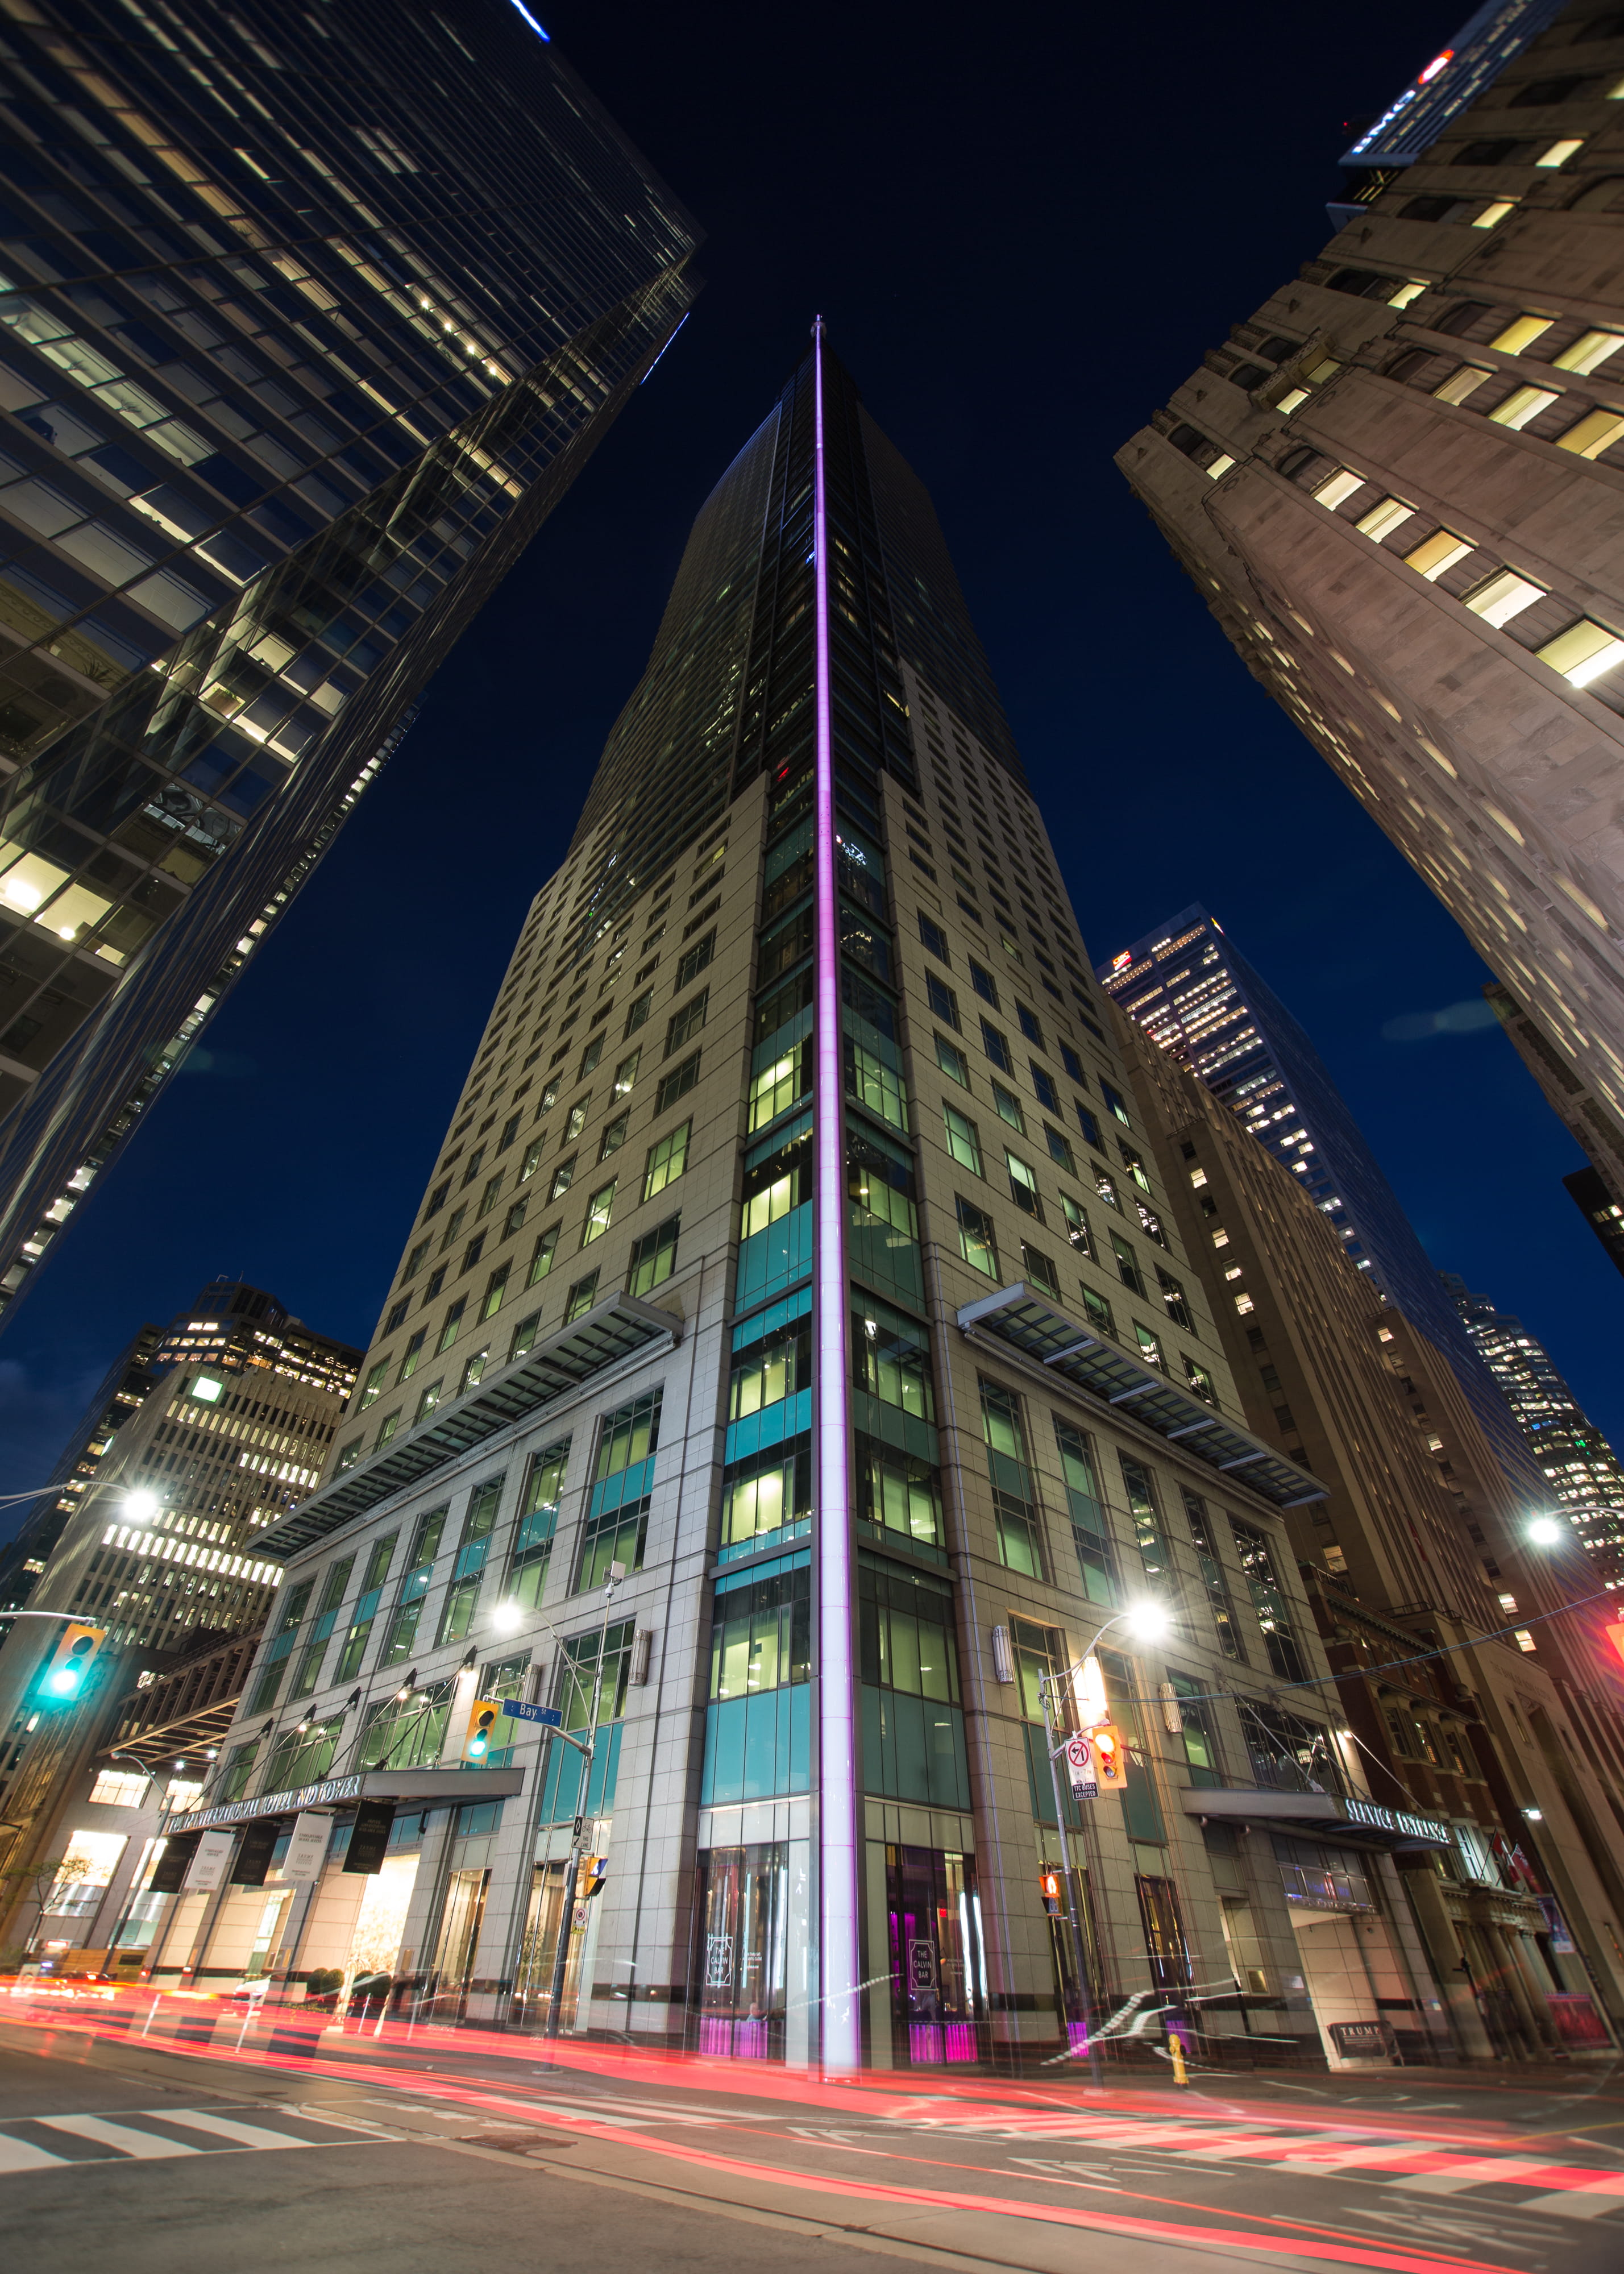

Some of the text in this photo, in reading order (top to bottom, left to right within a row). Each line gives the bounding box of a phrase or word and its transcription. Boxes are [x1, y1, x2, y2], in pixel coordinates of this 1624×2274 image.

[520, 1703, 537, 1720] Bay
[1345, 1798, 1451, 1844] SERVICE ENTRANCE
[913, 1960, 932, 1969] CALVIN
[1340, 2026, 1379, 2035] TRUMP
